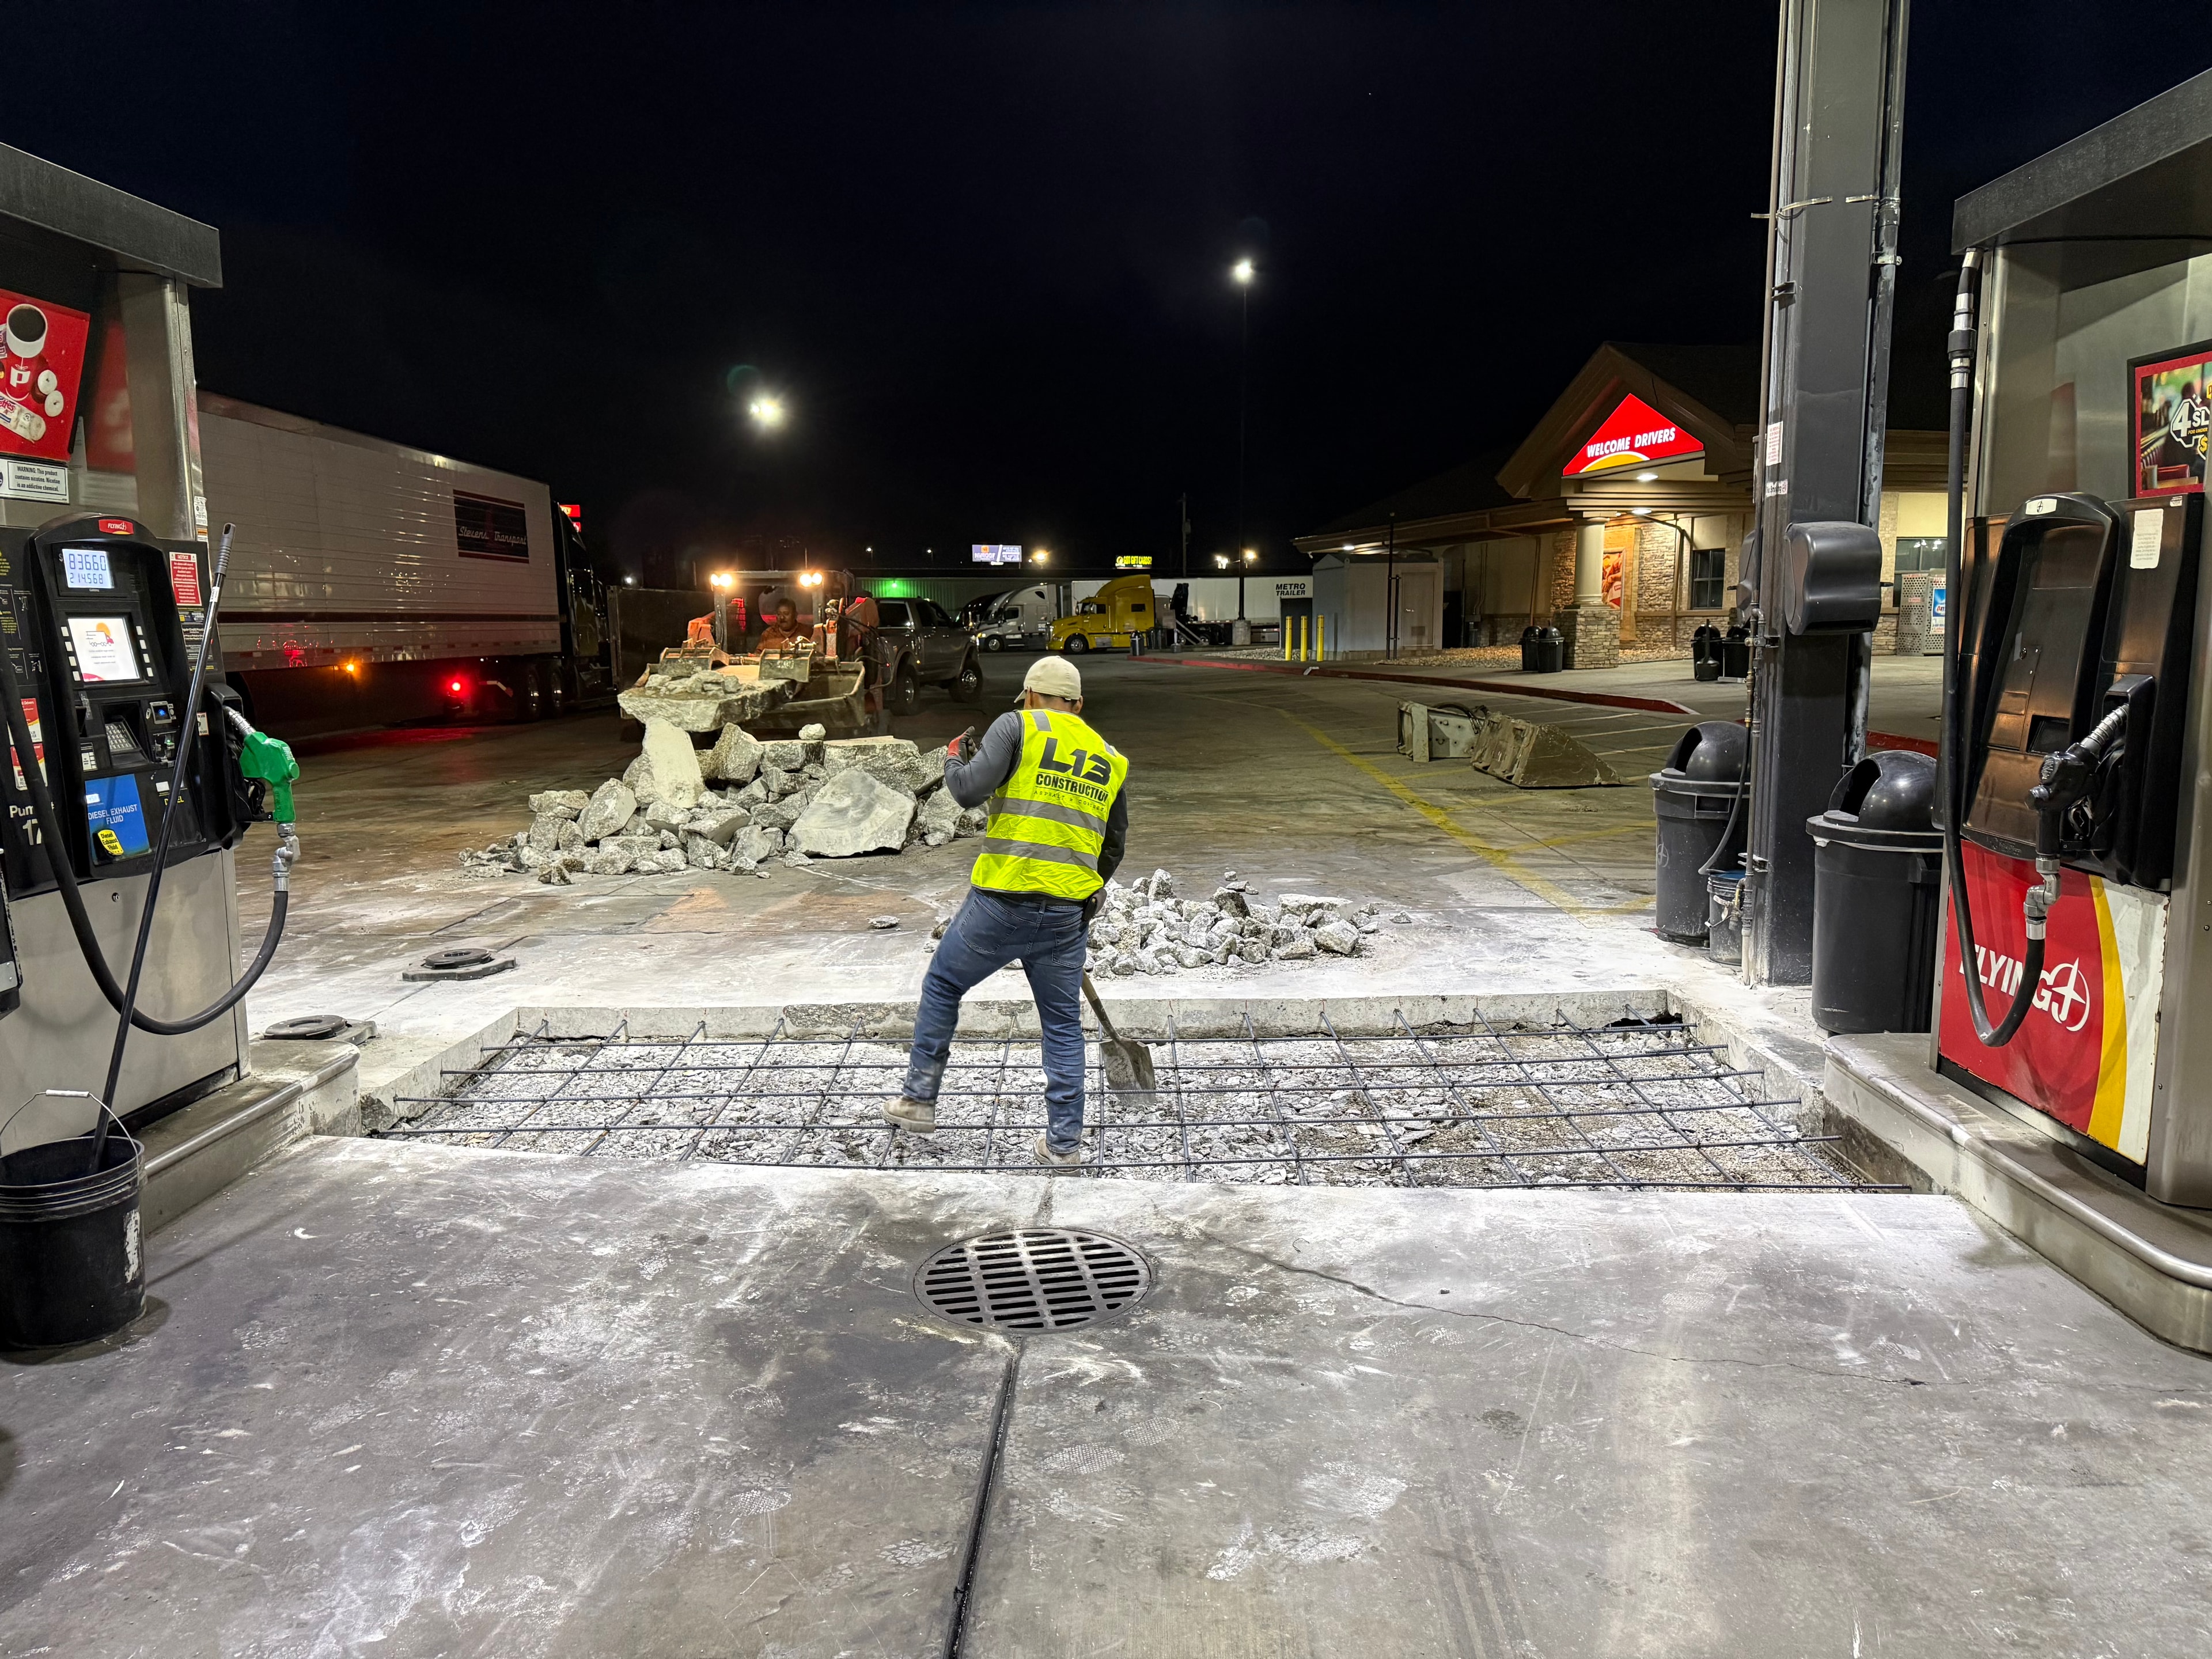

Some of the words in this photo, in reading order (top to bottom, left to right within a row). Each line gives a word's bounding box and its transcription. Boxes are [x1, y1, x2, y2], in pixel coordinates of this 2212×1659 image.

[2172, 402, 2191, 437] 4
[2192, 410, 2209, 427] SL
[1587, 437, 1631, 457] WELCOME
[1634, 427, 1676, 448] DRIVERS
[17, 465, 36, 474] WARNING:
[459, 525, 489, 540] Stevens
[494, 531, 528, 546] Transport
[1038, 737, 1112, 786] L13
[1035, 773, 1109, 803] CONSTRUCTION
[9, 805, 33, 818] Pum
[88, 810, 110, 820] DIESEL
[110, 804, 138, 816] EXHAUST
[1078, 799, 1105, 812] CONCRET
[106, 815, 124, 824] FLUID
